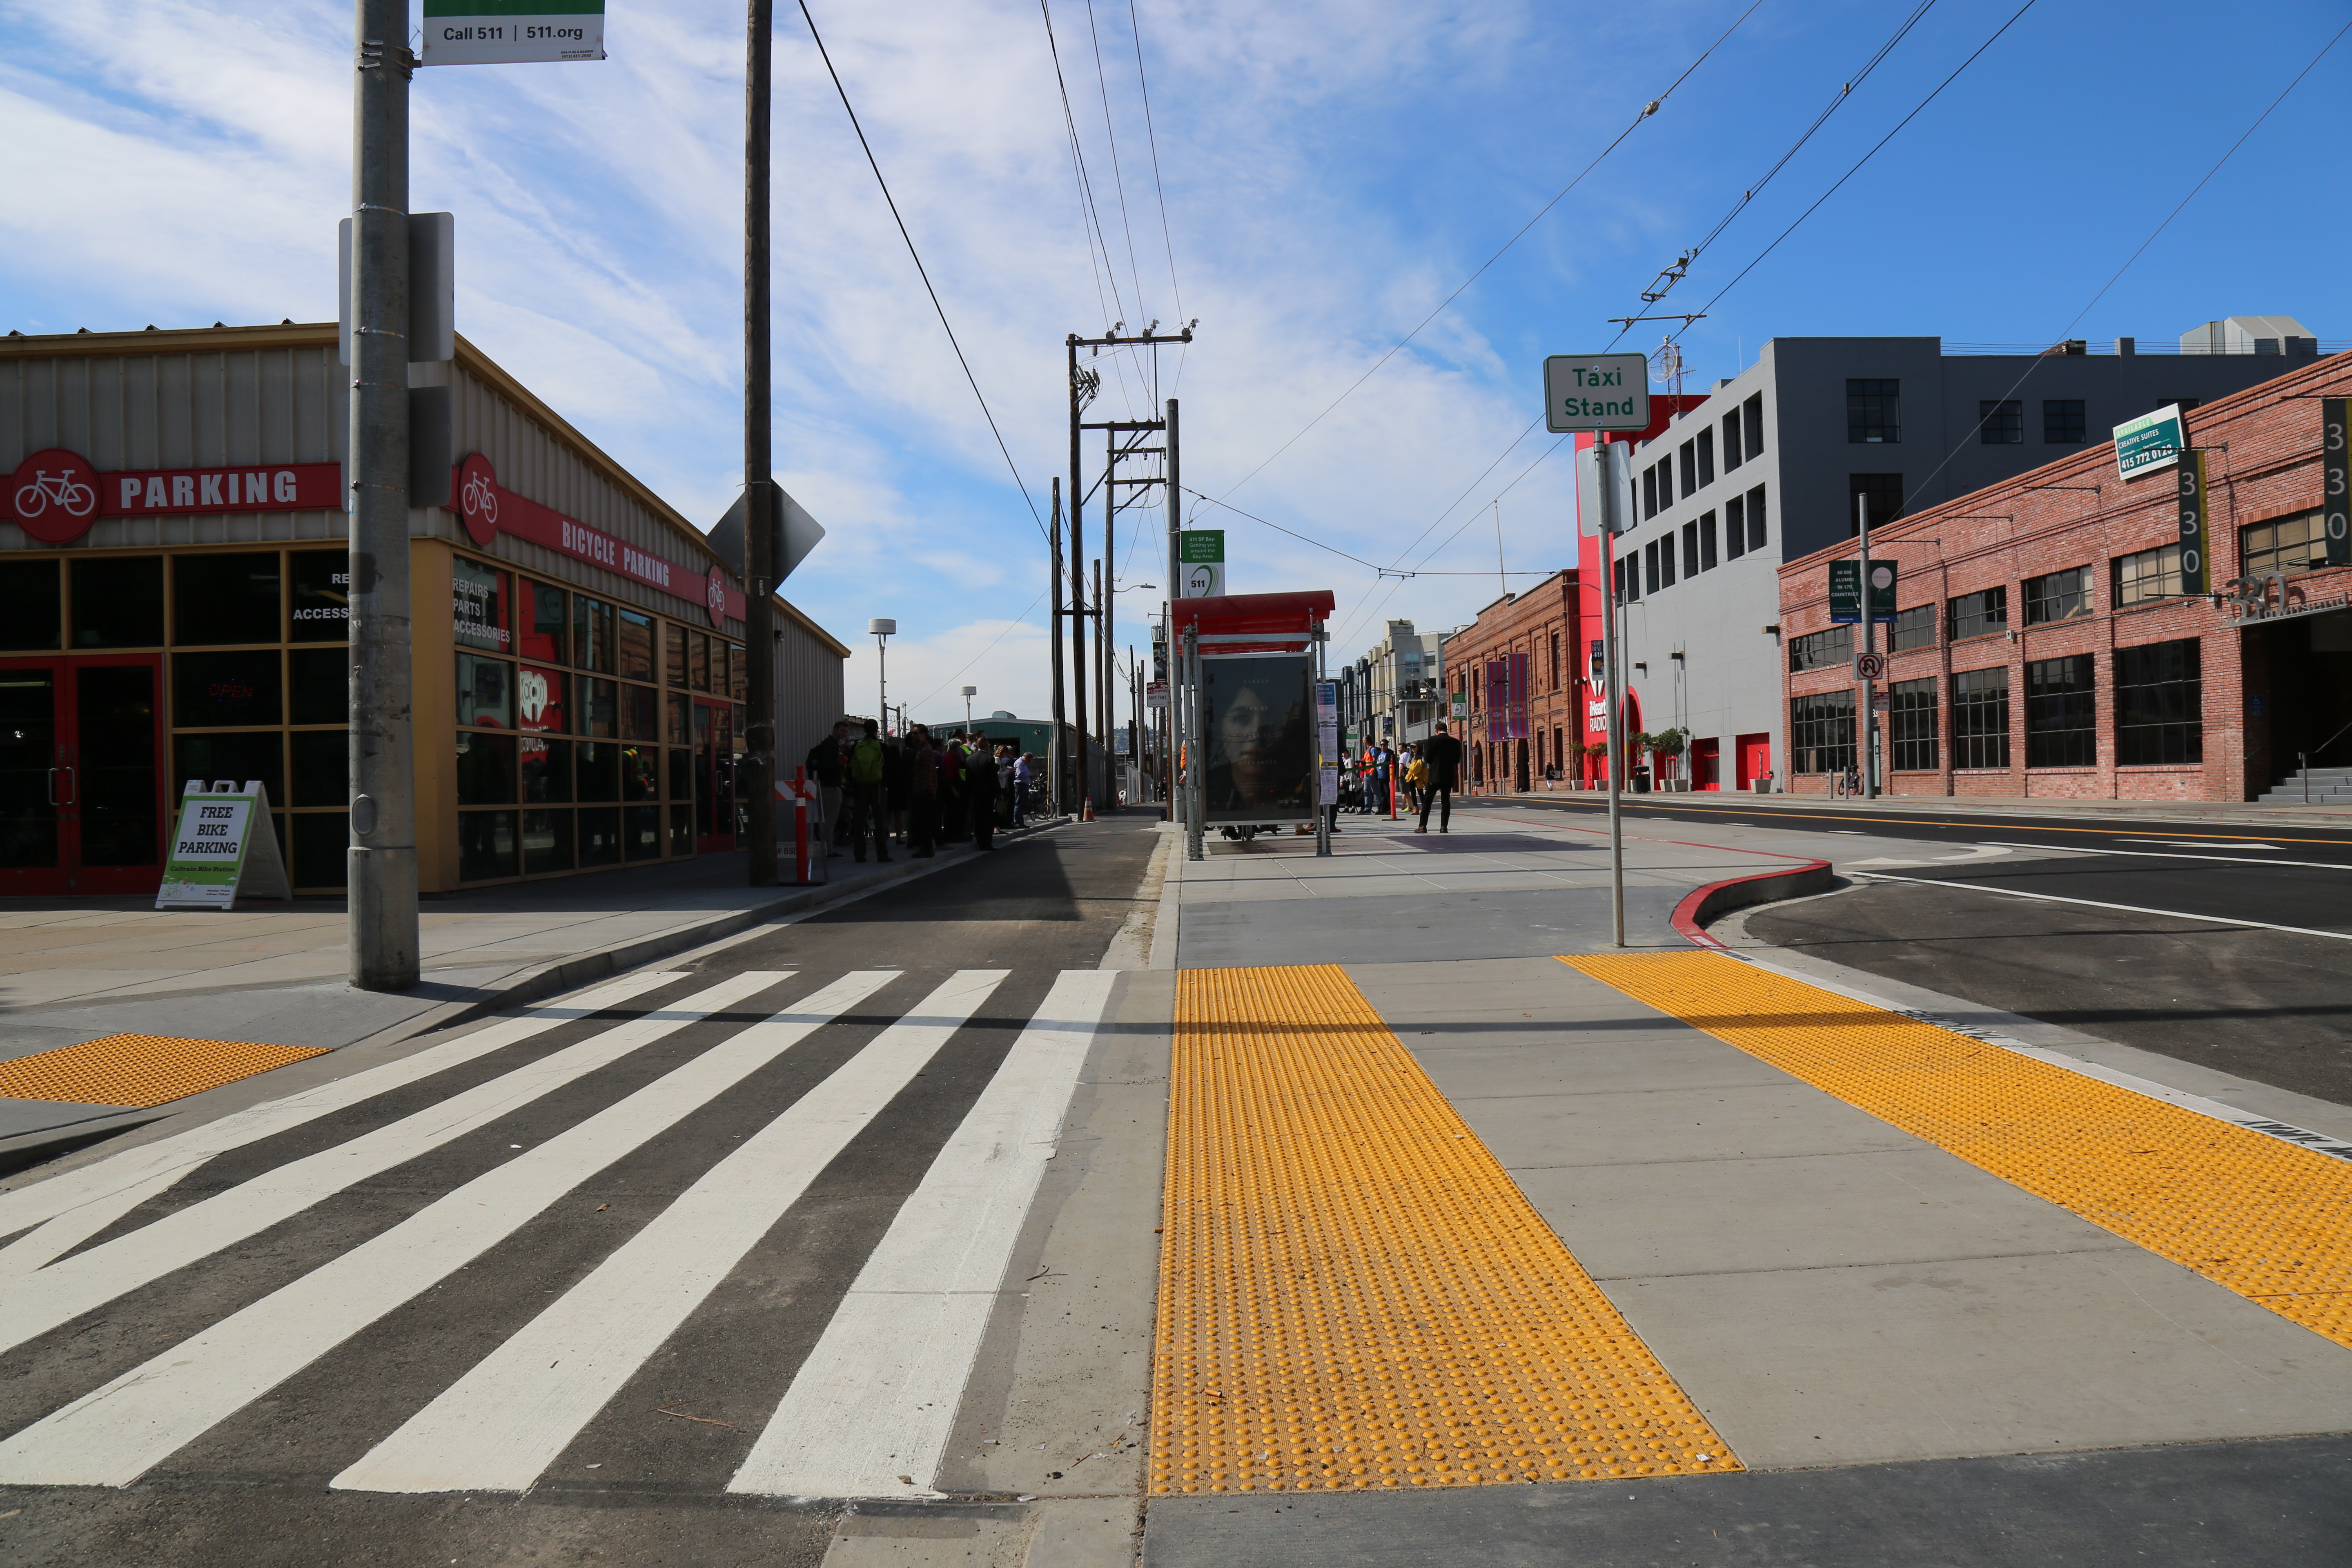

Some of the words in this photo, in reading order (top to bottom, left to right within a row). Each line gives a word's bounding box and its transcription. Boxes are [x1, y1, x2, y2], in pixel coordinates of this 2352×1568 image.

[443, 27, 472, 40] Call
[477, 27, 503, 40] 511
[526, 26, 583, 40] 511.org
[1572, 367, 1621, 387] Taxi
[1565, 396, 1634, 416] Stand
[2117, 418, 2150, 437] AVAILABLE
[2118, 435, 2140, 449] CREATIVE
[2141, 428, 2159, 441] SUITES
[2122, 457, 2134, 469] 415
[2135, 452, 2150, 465] 772
[2152, 444, 2172, 459] 0123
[120, 471, 297, 509] PARKING
[2200, 471, 2209, 572] TOWNSEND
[563, 521, 615, 566] BICYCLE
[624, 546, 669, 587] PARKING
[453, 577, 488, 599] REPAIRS
[453, 598, 481, 617] PARTS
[454, 619, 510, 643] ACCESSORIES
[209, 684, 254, 699] OPEN
[1589, 699, 1606, 717] iHeart
[1590, 716, 1607, 733] RADIO
[200, 806, 233, 818] FREE
[197, 824, 229, 836] BIKE
[178, 842, 238, 854] PARKING
